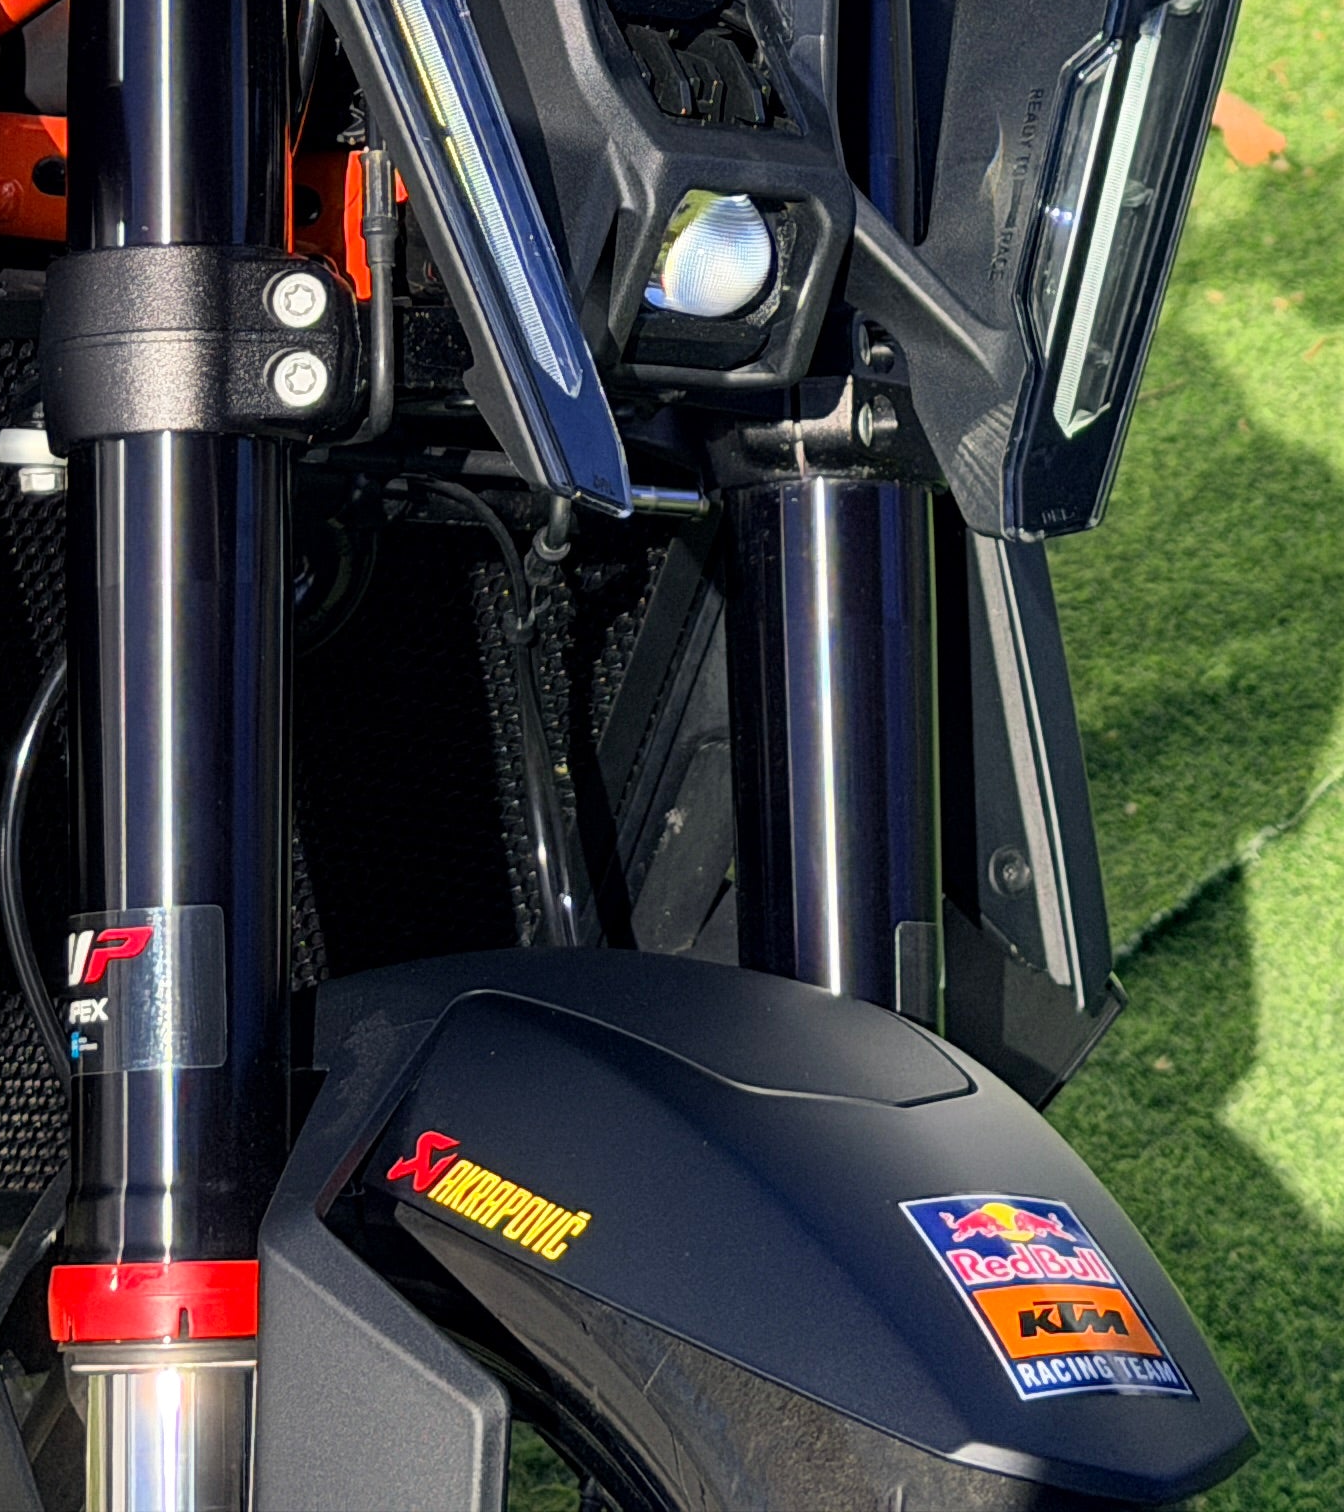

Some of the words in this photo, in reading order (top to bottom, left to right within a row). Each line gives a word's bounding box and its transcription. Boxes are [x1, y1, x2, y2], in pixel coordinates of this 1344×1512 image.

[1020, 88, 1045, 149] READY
[987, 227, 1013, 282] RACE
[1017, 1300, 1130, 1338] KTM
[1016, 1356, 1114, 1388] RACING
[1115, 1356, 1180, 1384] TEAM
